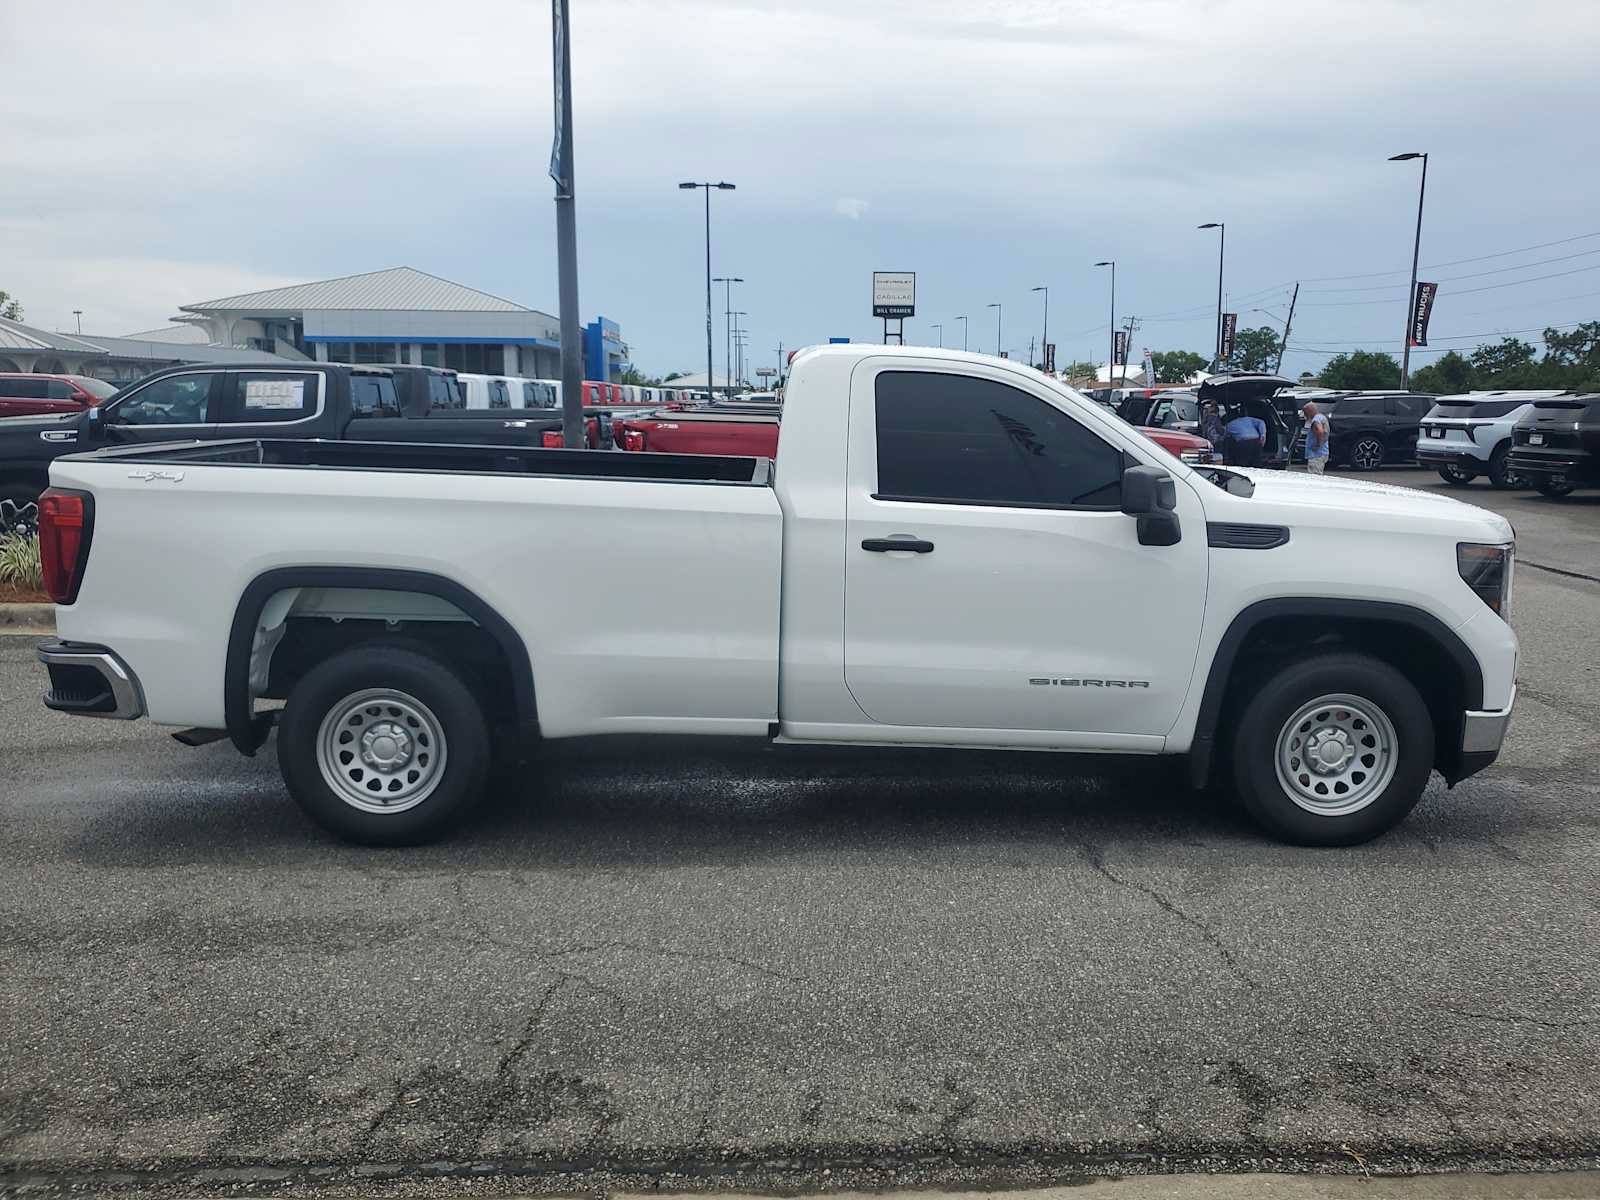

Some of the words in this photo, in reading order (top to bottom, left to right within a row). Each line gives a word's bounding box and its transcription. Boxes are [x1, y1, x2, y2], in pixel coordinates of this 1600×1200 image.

[1417, 286, 1431, 321] TRUCKS
[1415, 322, 1423, 343] NEW
[1028, 678, 1150, 689] SIERRA
